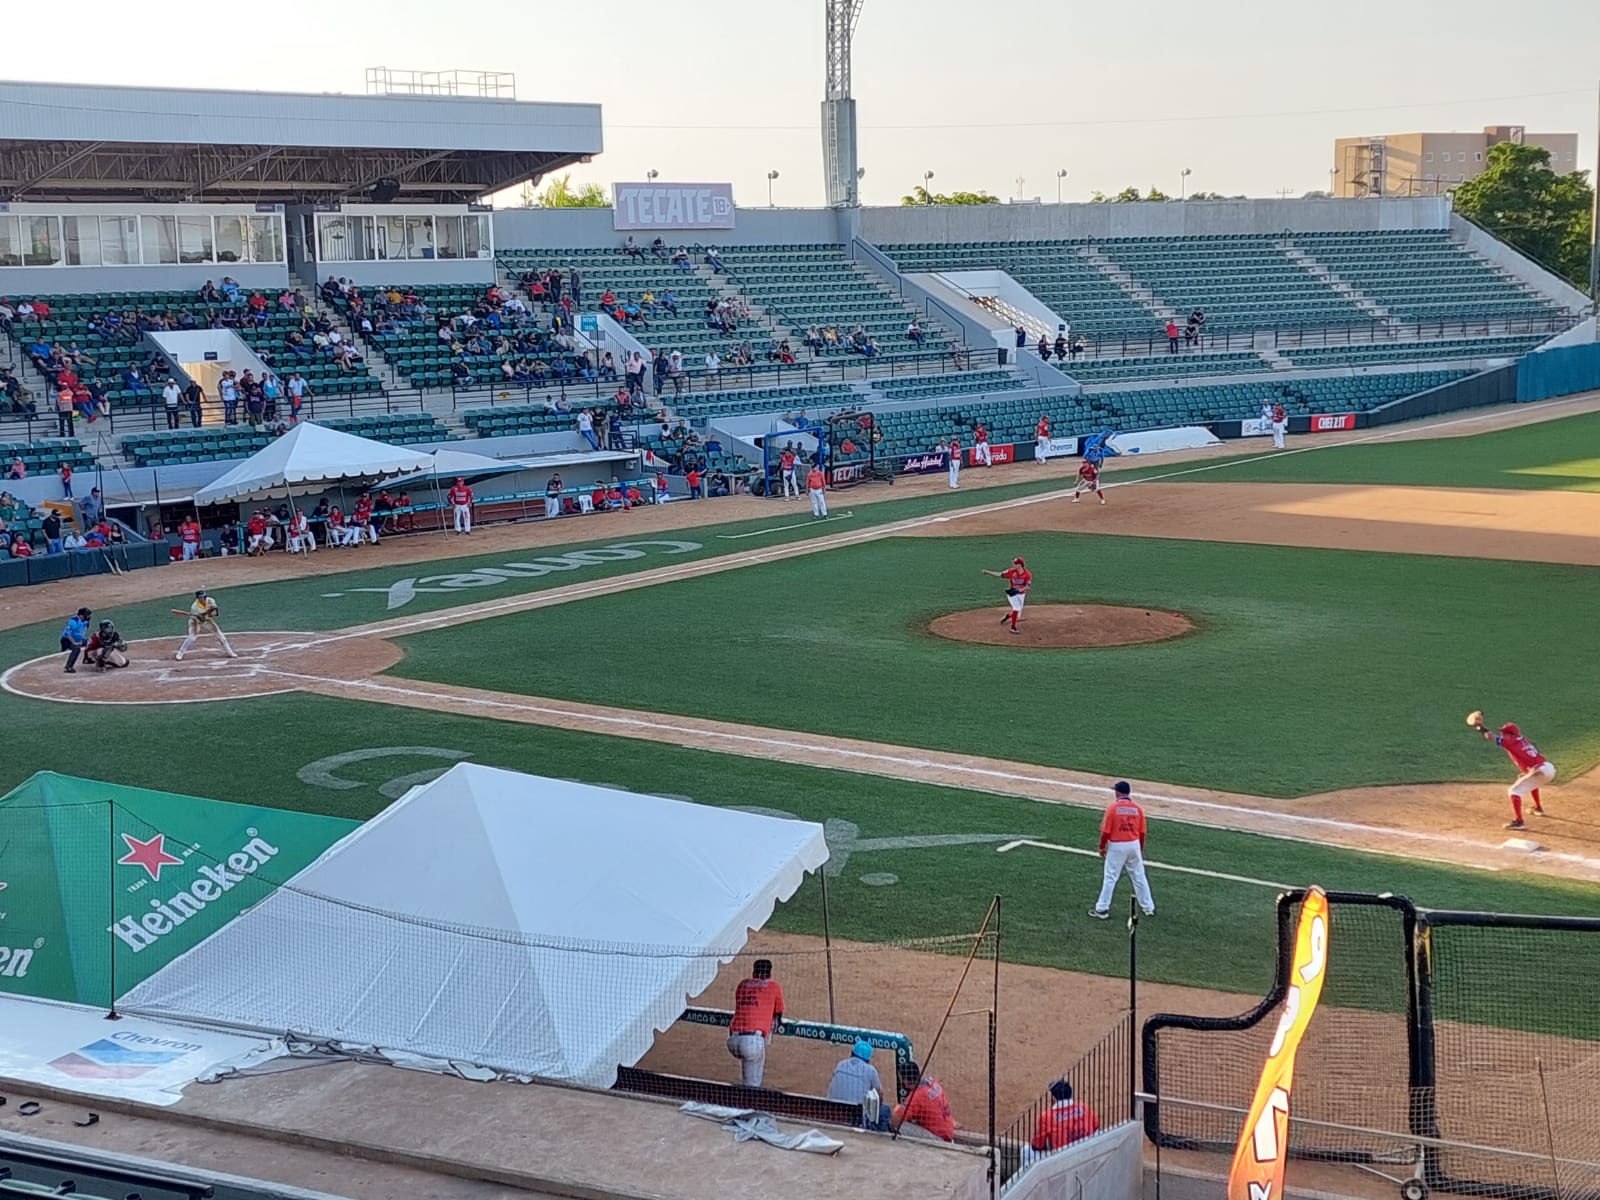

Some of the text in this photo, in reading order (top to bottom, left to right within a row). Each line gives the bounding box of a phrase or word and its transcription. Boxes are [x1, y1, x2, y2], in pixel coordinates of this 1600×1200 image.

[619, 188, 712, 224] TECATE
[832, 464, 865, 482] TECATE
[107, 836, 279, 953] Heineken
[111, 1031, 202, 1052] Chevron
[687, 1013, 708, 1022] ARCO
[795, 1027, 817, 1038] ARCO
[831, 1032, 854, 1043] ARCO
[867, 1037, 890, 1049] ARCO
